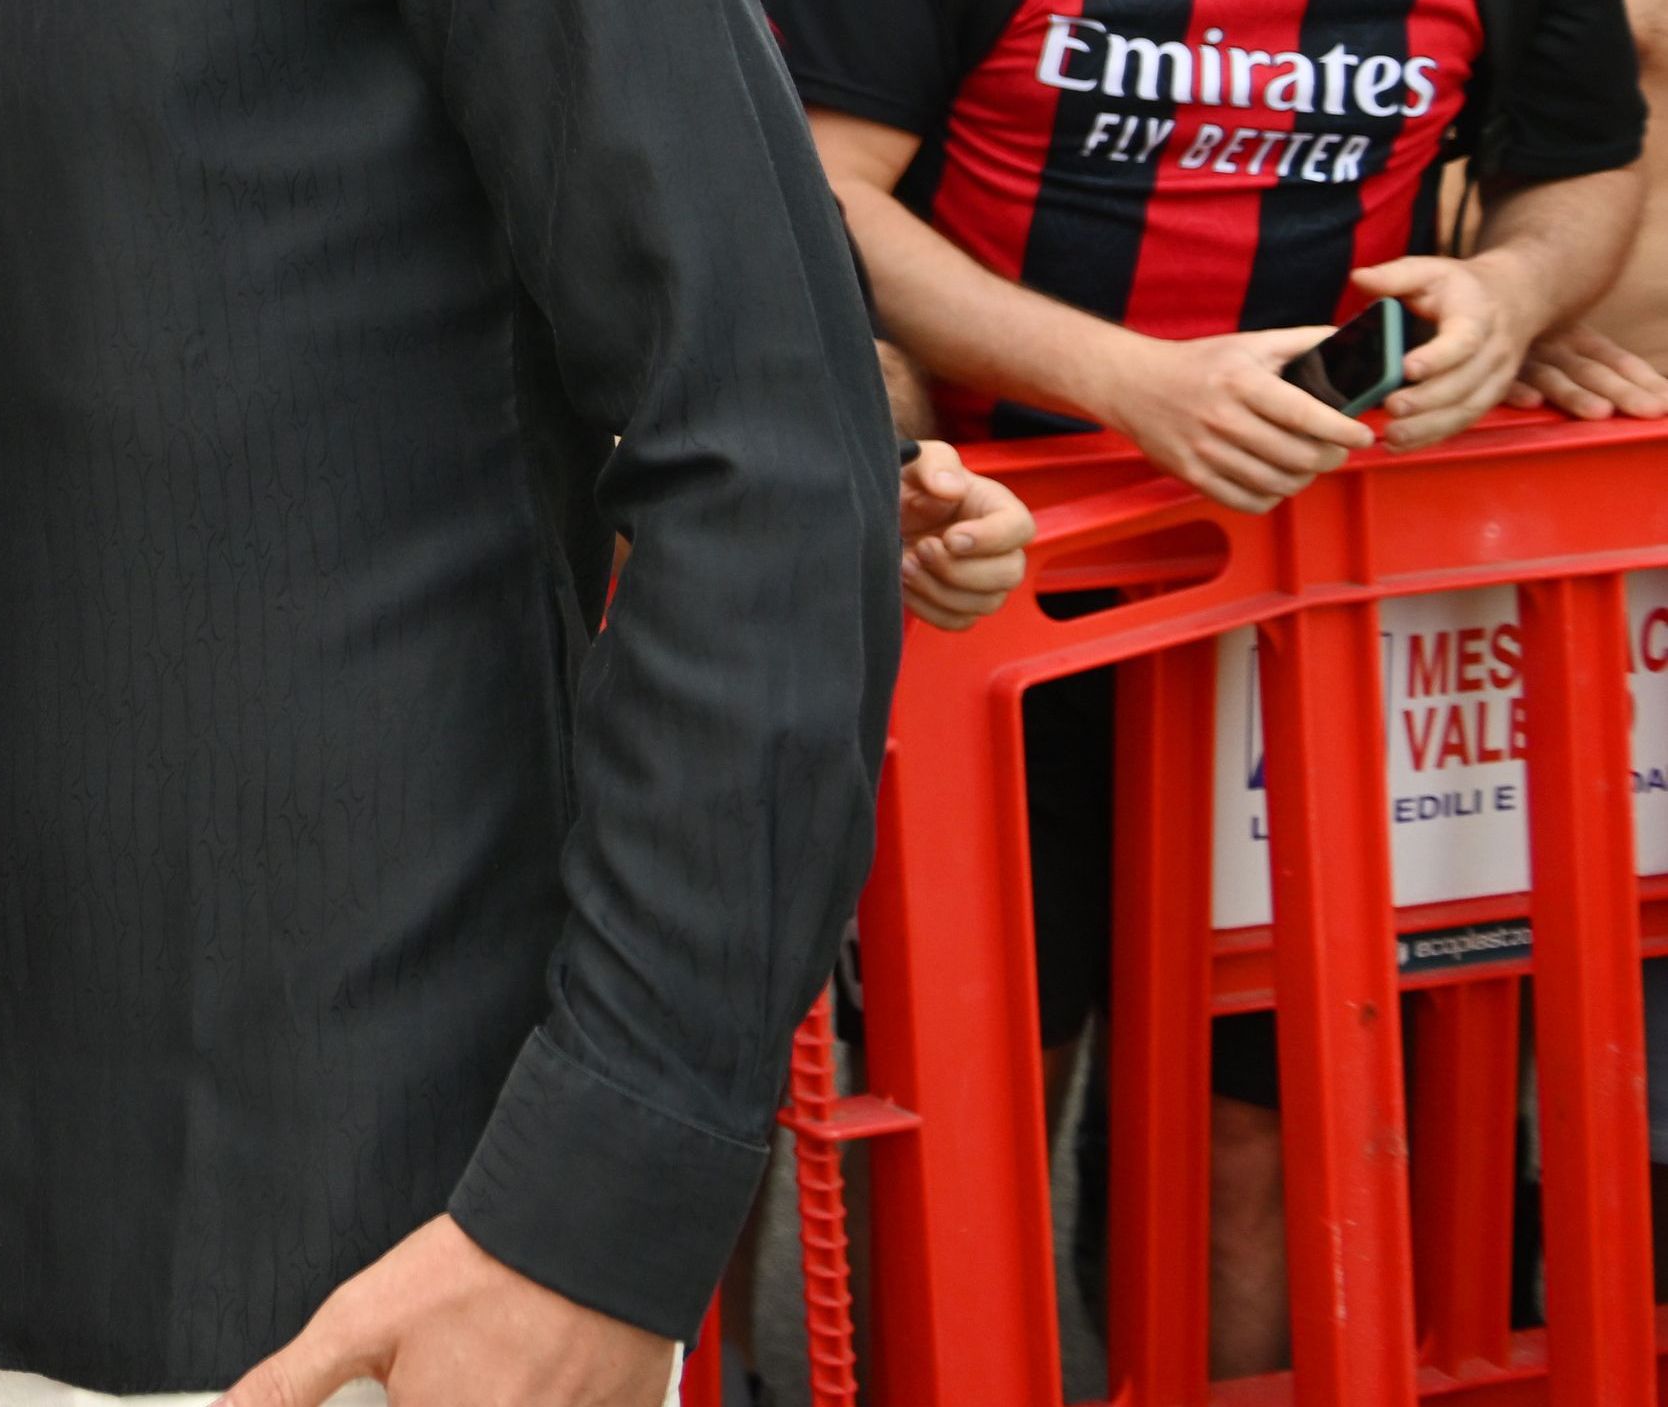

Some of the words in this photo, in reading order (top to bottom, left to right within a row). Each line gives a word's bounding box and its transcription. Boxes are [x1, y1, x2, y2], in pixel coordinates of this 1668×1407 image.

[1035, 14, 1437, 117] Emirates
[1081, 111, 1175, 164] FLY
[1178, 123, 1370, 184] BETTER
[1393, 790, 1482, 824] EDILI
[1494, 785, 1516, 811] E
